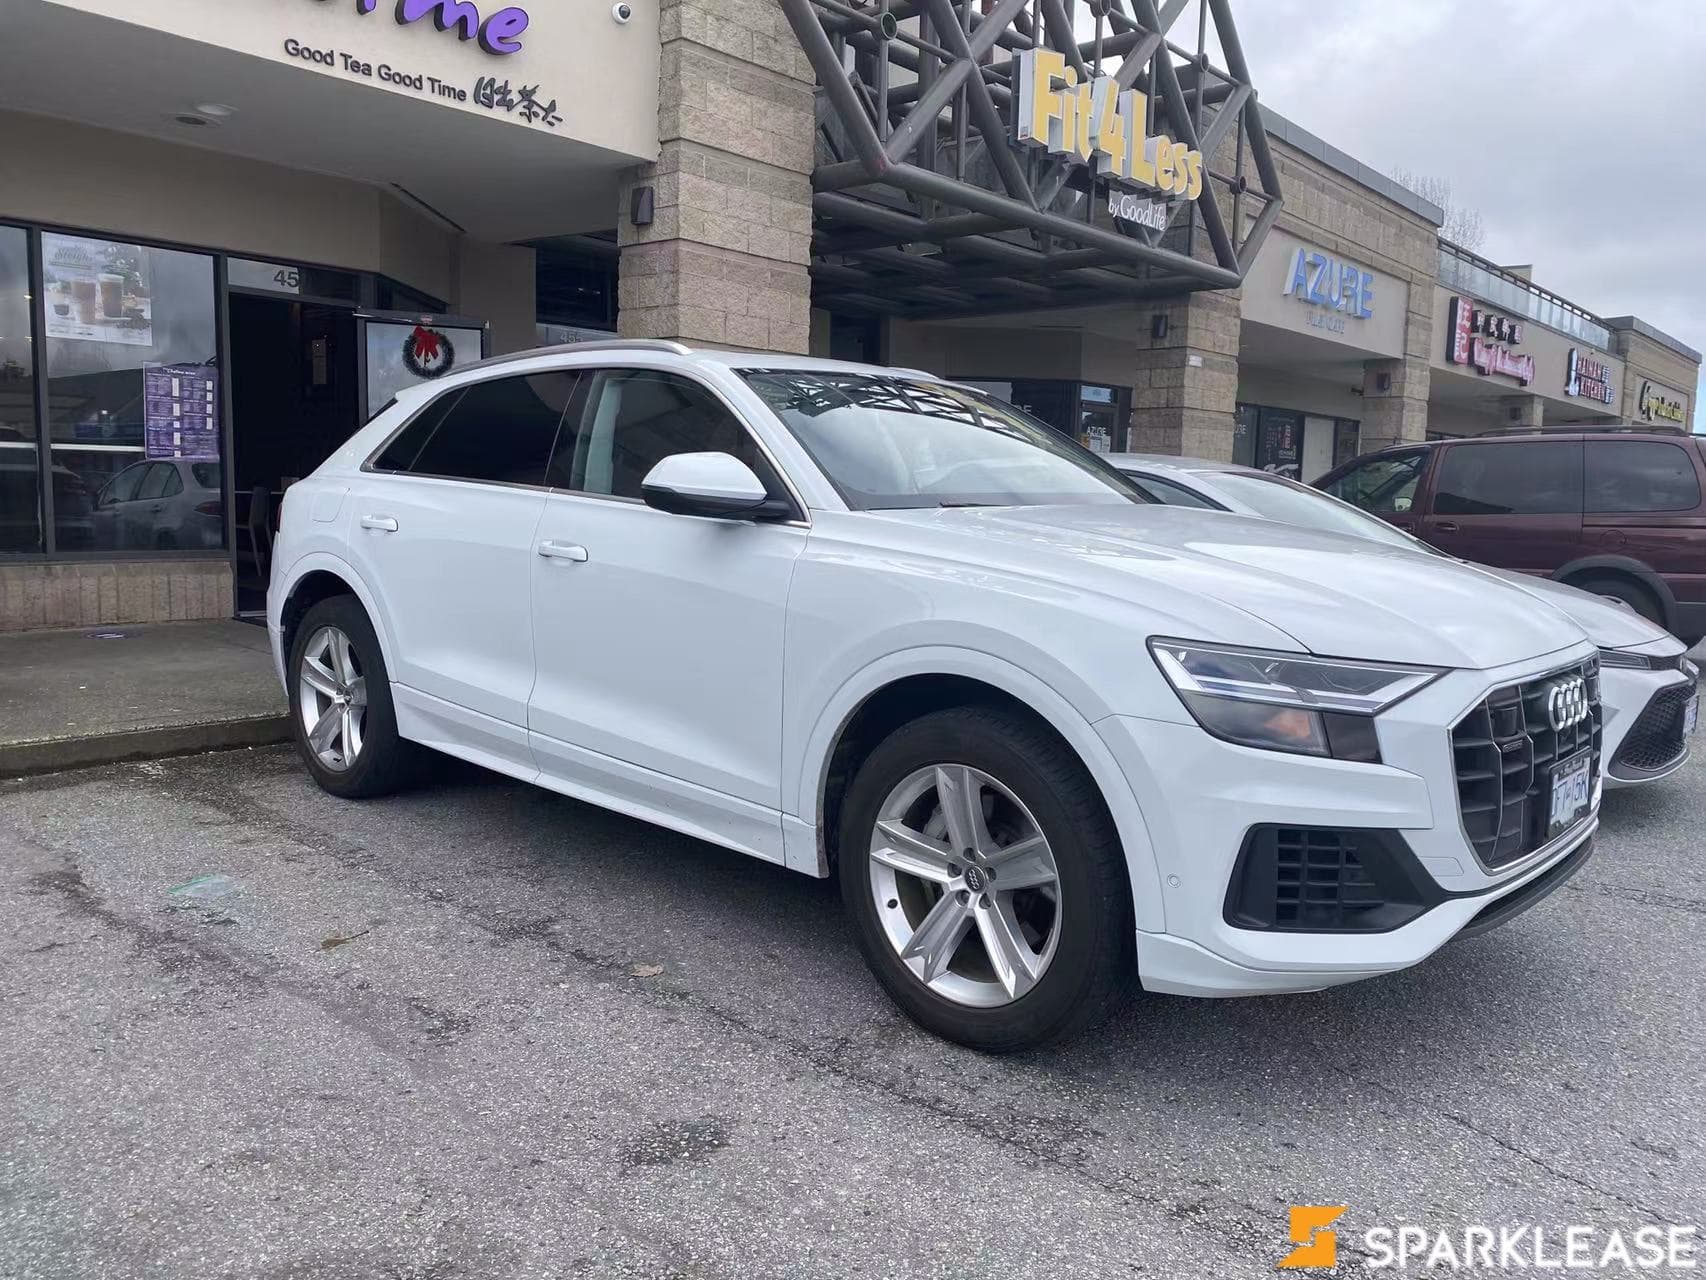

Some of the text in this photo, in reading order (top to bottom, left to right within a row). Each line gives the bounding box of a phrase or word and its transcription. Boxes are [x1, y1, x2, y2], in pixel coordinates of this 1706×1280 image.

[284, 38, 468, 102] Good Tea Good Time
[1108, 195, 1167, 231] by GoodLife
[273, 269, 300, 288] 45
[1287, 247, 1375, 319] AZURE
